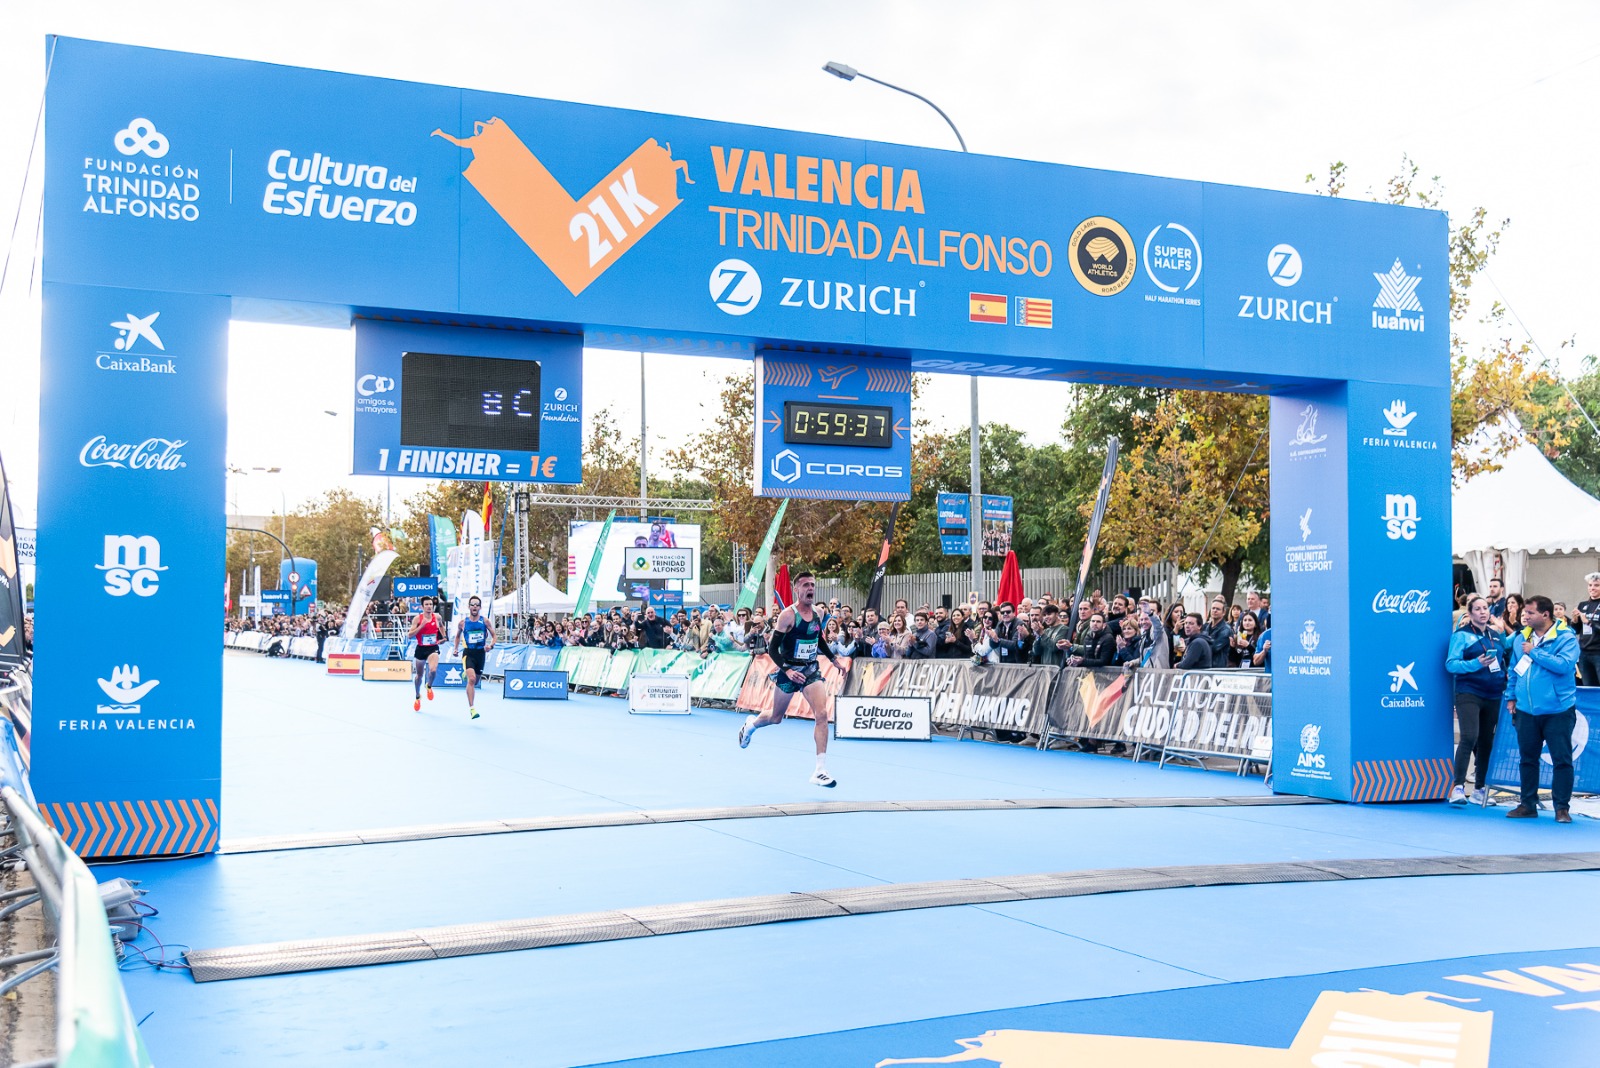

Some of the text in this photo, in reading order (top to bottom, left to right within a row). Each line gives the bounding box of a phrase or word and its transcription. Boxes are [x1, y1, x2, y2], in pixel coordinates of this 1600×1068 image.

[84, 157, 199, 180] FUNDACIÓN
[267, 149, 417, 193] Cultura del
[83, 173, 200, 202] TRINIDAD
[709, 145, 925, 215] VALENCIA
[83, 195, 200, 222] ALFONSO
[262, 182, 418, 227] Esfuerzo
[569, 167, 659, 269] 21K
[708, 206, 1053, 278] TRINIDAD ALFONSO
[1071, 221, 1097, 247] GOLD LABEL
[1154, 245, 1191, 260] SUPER
[1092, 263, 1113, 271] WORLD
[1154, 257, 1191, 272] HALFS
[1087, 269, 1118, 277] ATHLETICS
[1101, 285, 1118, 293] ROAD
[1117, 276, 1129, 289] RACE
[779, 277, 917, 317] ZURICH
[1144, 294, 1201, 307] HALF MARATHON SERIES
[1238, 295, 1333, 325] ZURICH
[1372, 310, 1425, 332] luanvi
[96, 354, 178, 375] CaixaBank
[911, 358, 1053, 377] GRAN
[357, 397, 387, 407] amigos
[364, 405, 398, 414] mayores
[543, 402, 578, 412] ZURICH
[540, 411, 581, 423] Foundation
[794, 410, 885, 437] 0:59:37
[1363, 437, 1437, 450] FERIA VALENCIA
[79, 435, 189, 471] Coca-Cola
[379, 448, 390, 472] 1
[398, 449, 501, 476] FINISHER
[529, 455, 559, 478] 1€
[806, 463, 903, 478] COROS
[1285, 550, 1327, 563] COMUNITAT
[1288, 560, 1333, 572] DE L'ESPORT
[1372, 588, 1431, 614] Coca-Cola
[1288, 655, 1331, 665] AJUNTAMENT
[1288, 665, 1331, 676] DE VALÈNCIA
[527, 681, 563, 689] ZURICH
[1381, 696, 1425, 708] CaixaBank
[855, 706, 901, 717] Cultura
[59, 718, 196, 731] FERIA VALENCIA
[853, 717, 913, 730] Esfuerzo
[1123, 705, 1199, 739] CIUDAD
[1199, 711, 1240, 748] DEL
[1297, 752, 1326, 768] AIMS
